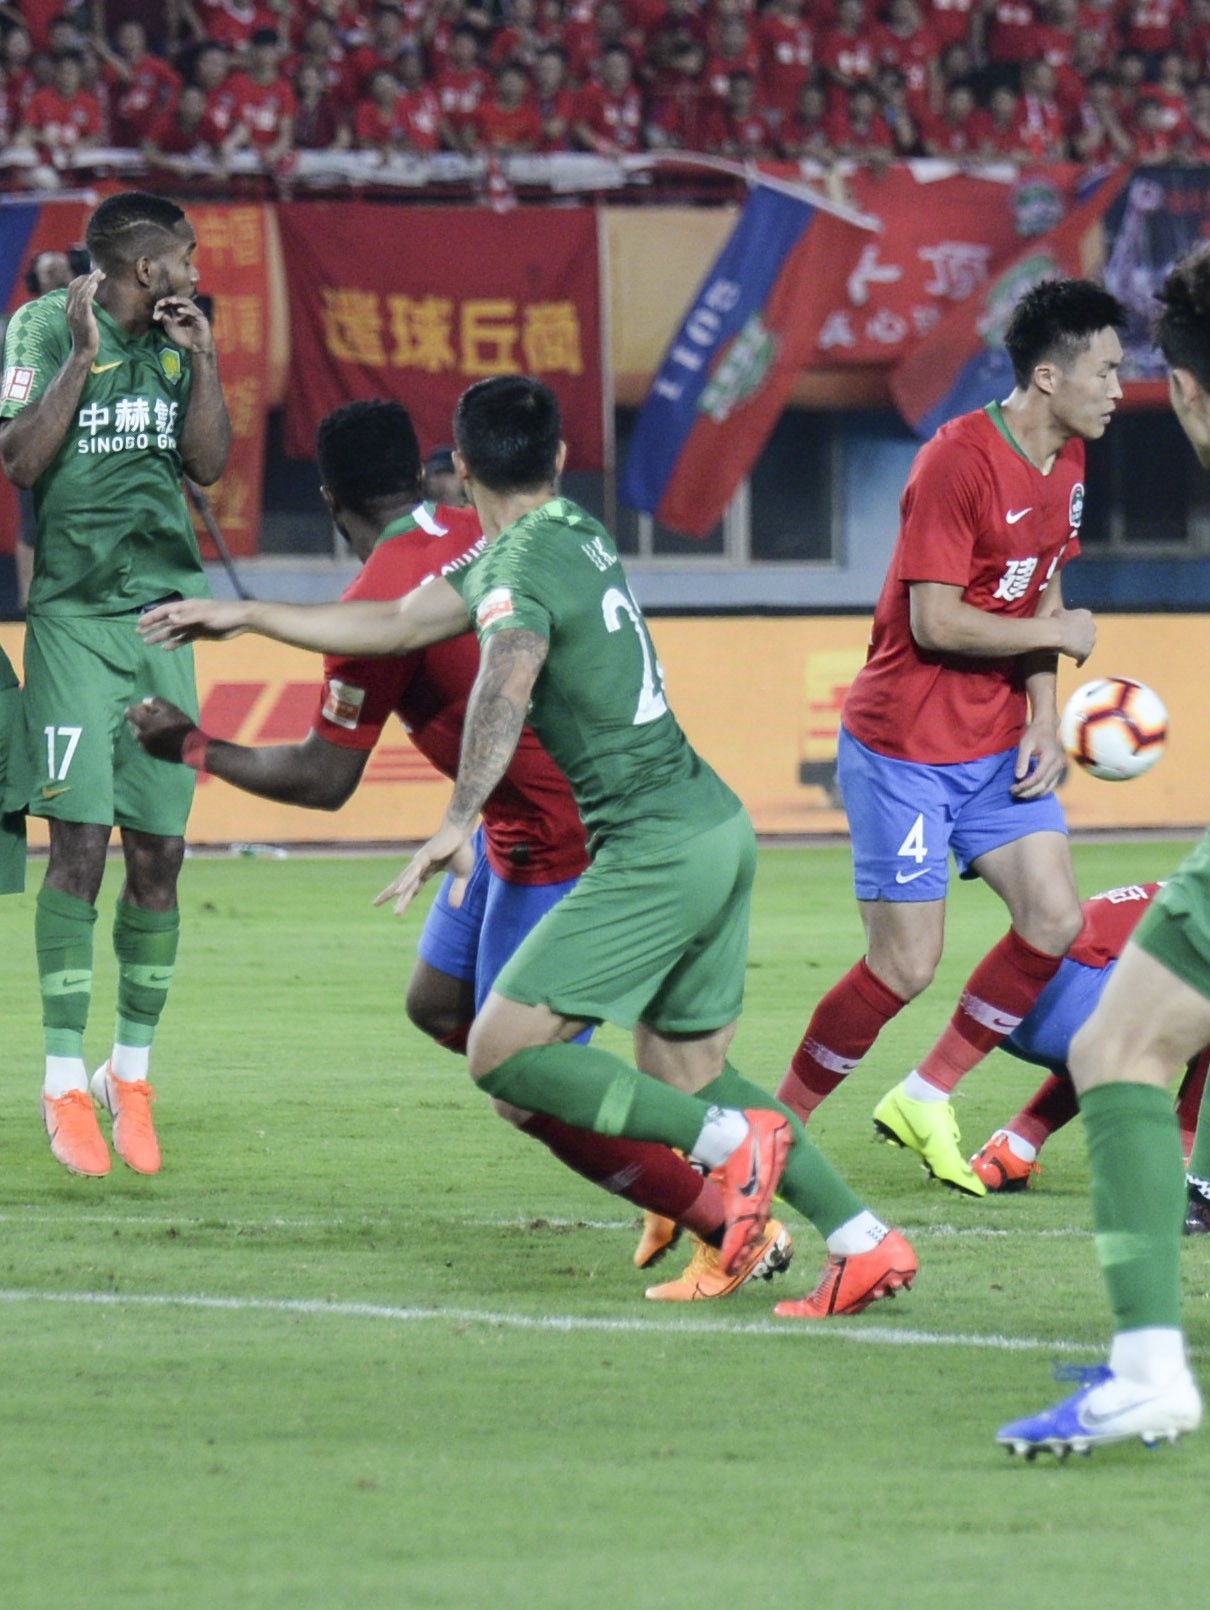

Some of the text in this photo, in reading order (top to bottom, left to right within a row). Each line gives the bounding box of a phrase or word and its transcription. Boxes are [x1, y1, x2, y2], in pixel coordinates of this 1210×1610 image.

[78, 434, 148, 454] SINOBO
[44, 726, 83, 781] 17
[897, 812, 928, 864] 4
